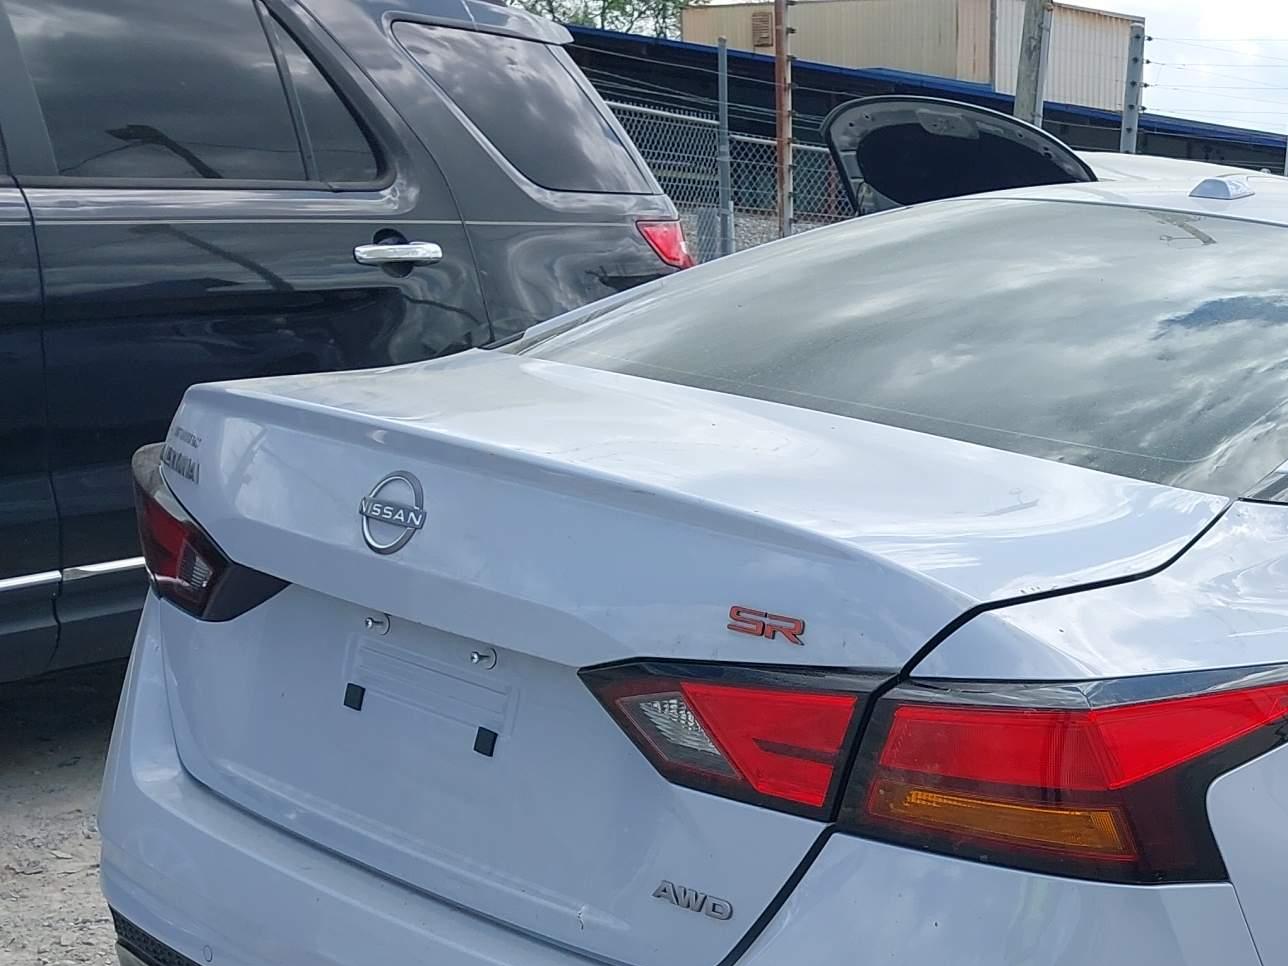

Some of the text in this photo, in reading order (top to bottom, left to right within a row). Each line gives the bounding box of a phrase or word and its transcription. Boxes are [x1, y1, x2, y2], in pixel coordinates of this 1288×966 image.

[361, 499, 422, 526] NISSAN
[727, 605, 805, 646] SR
[652, 880, 734, 920] AWD
